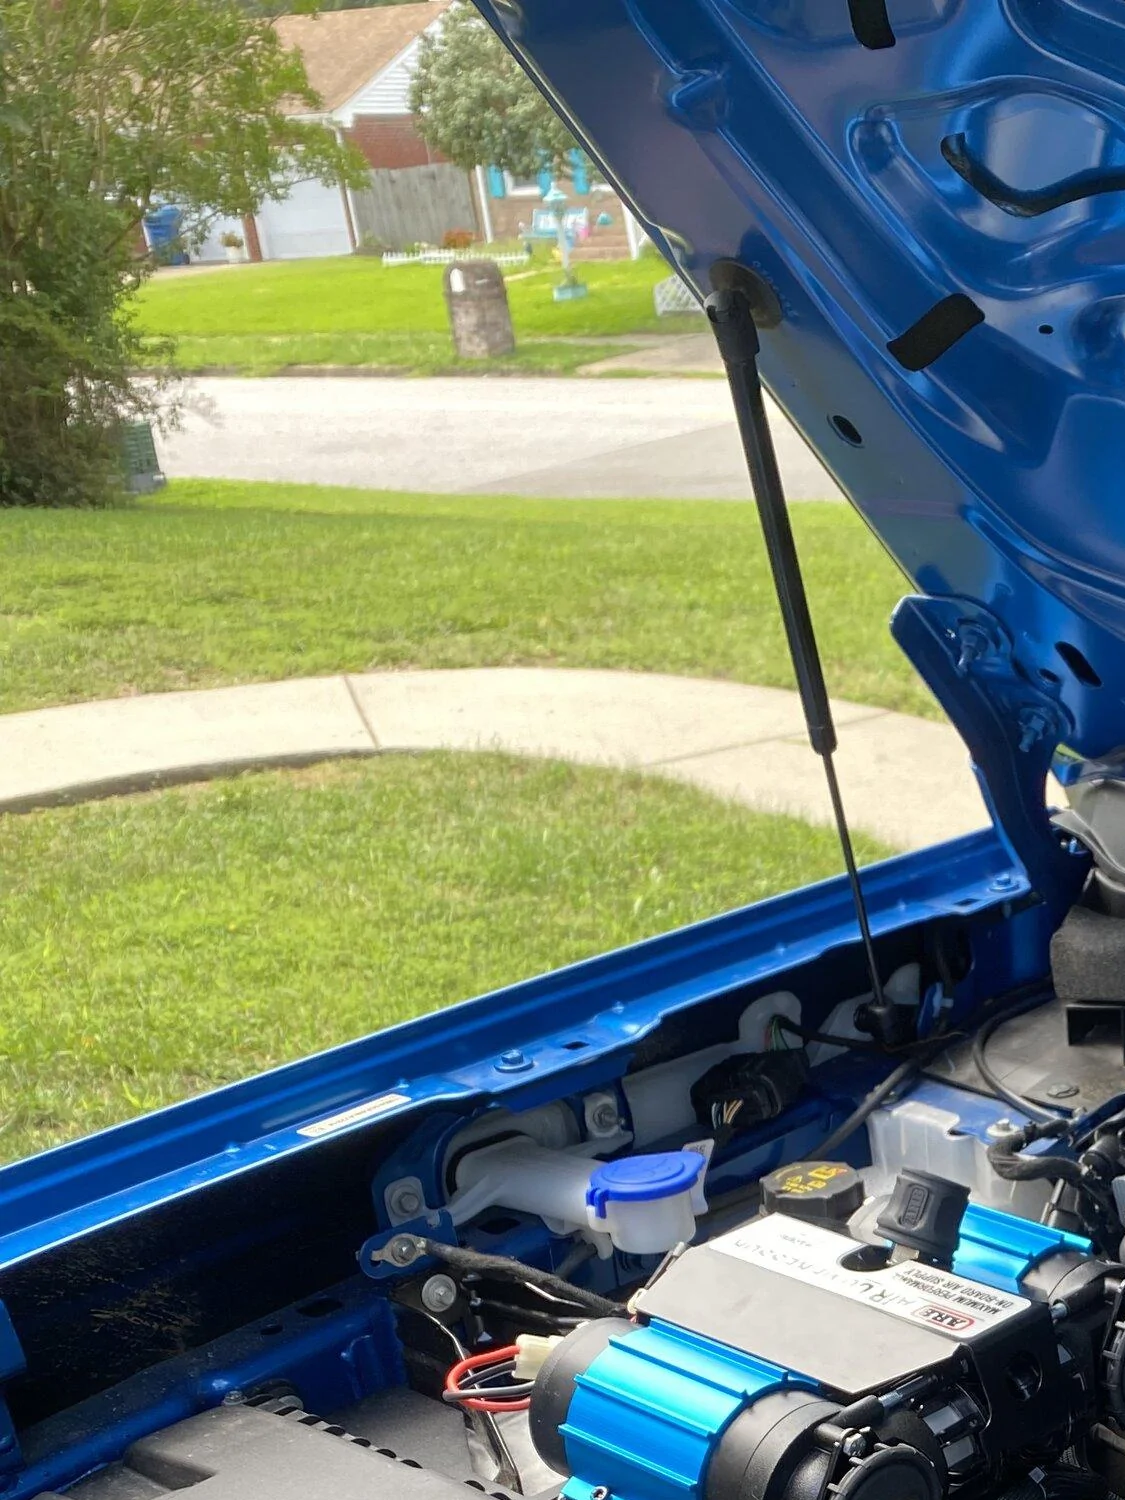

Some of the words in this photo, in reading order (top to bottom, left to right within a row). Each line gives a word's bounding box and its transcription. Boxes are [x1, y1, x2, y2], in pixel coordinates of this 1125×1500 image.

[904, 1267, 943, 1284] SUPPLY
[942, 1281, 962, 1290] AIR
[954, 1296, 1001, 1315] MAXIMUM
